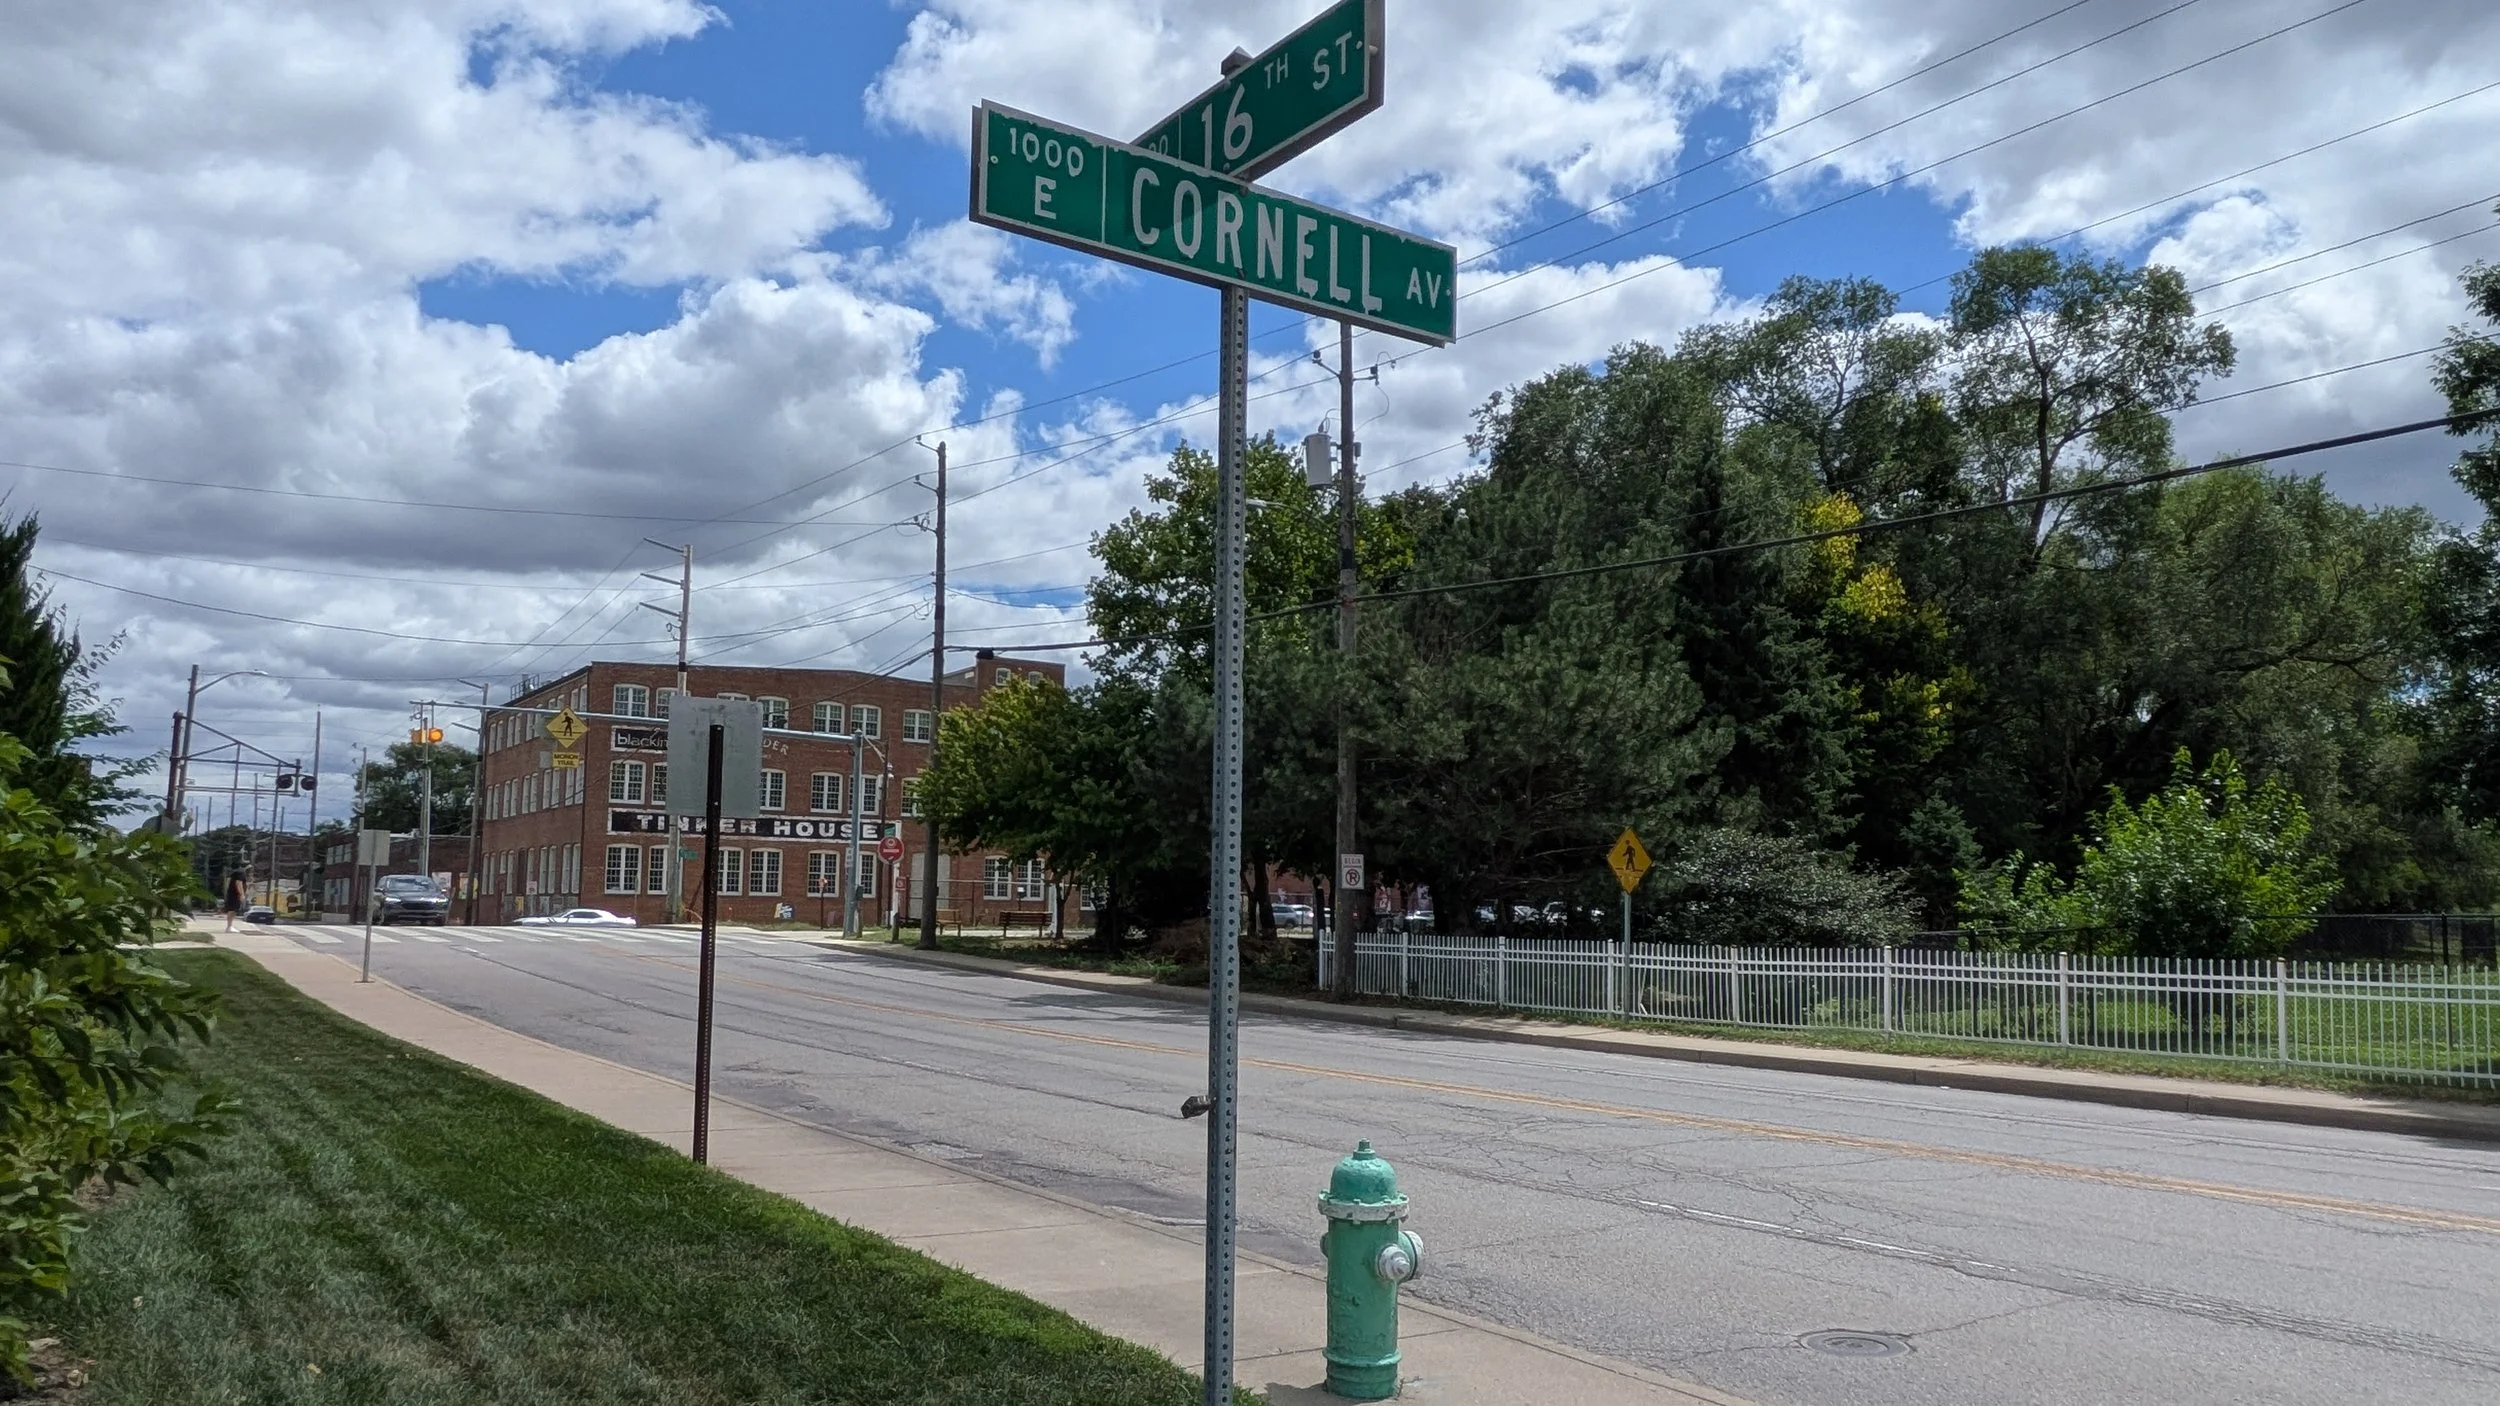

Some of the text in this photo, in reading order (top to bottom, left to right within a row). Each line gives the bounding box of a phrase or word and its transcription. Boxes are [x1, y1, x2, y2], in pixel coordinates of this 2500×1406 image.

[1202, 84, 1253, 169] 16
[1264, 53, 1288, 89] TH
[1010, 128, 1084, 177] 1000
[1035, 176, 1056, 220] E
[1132, 167, 1382, 313] CORNELL
[773, 820, 878, 838] HOUSE
